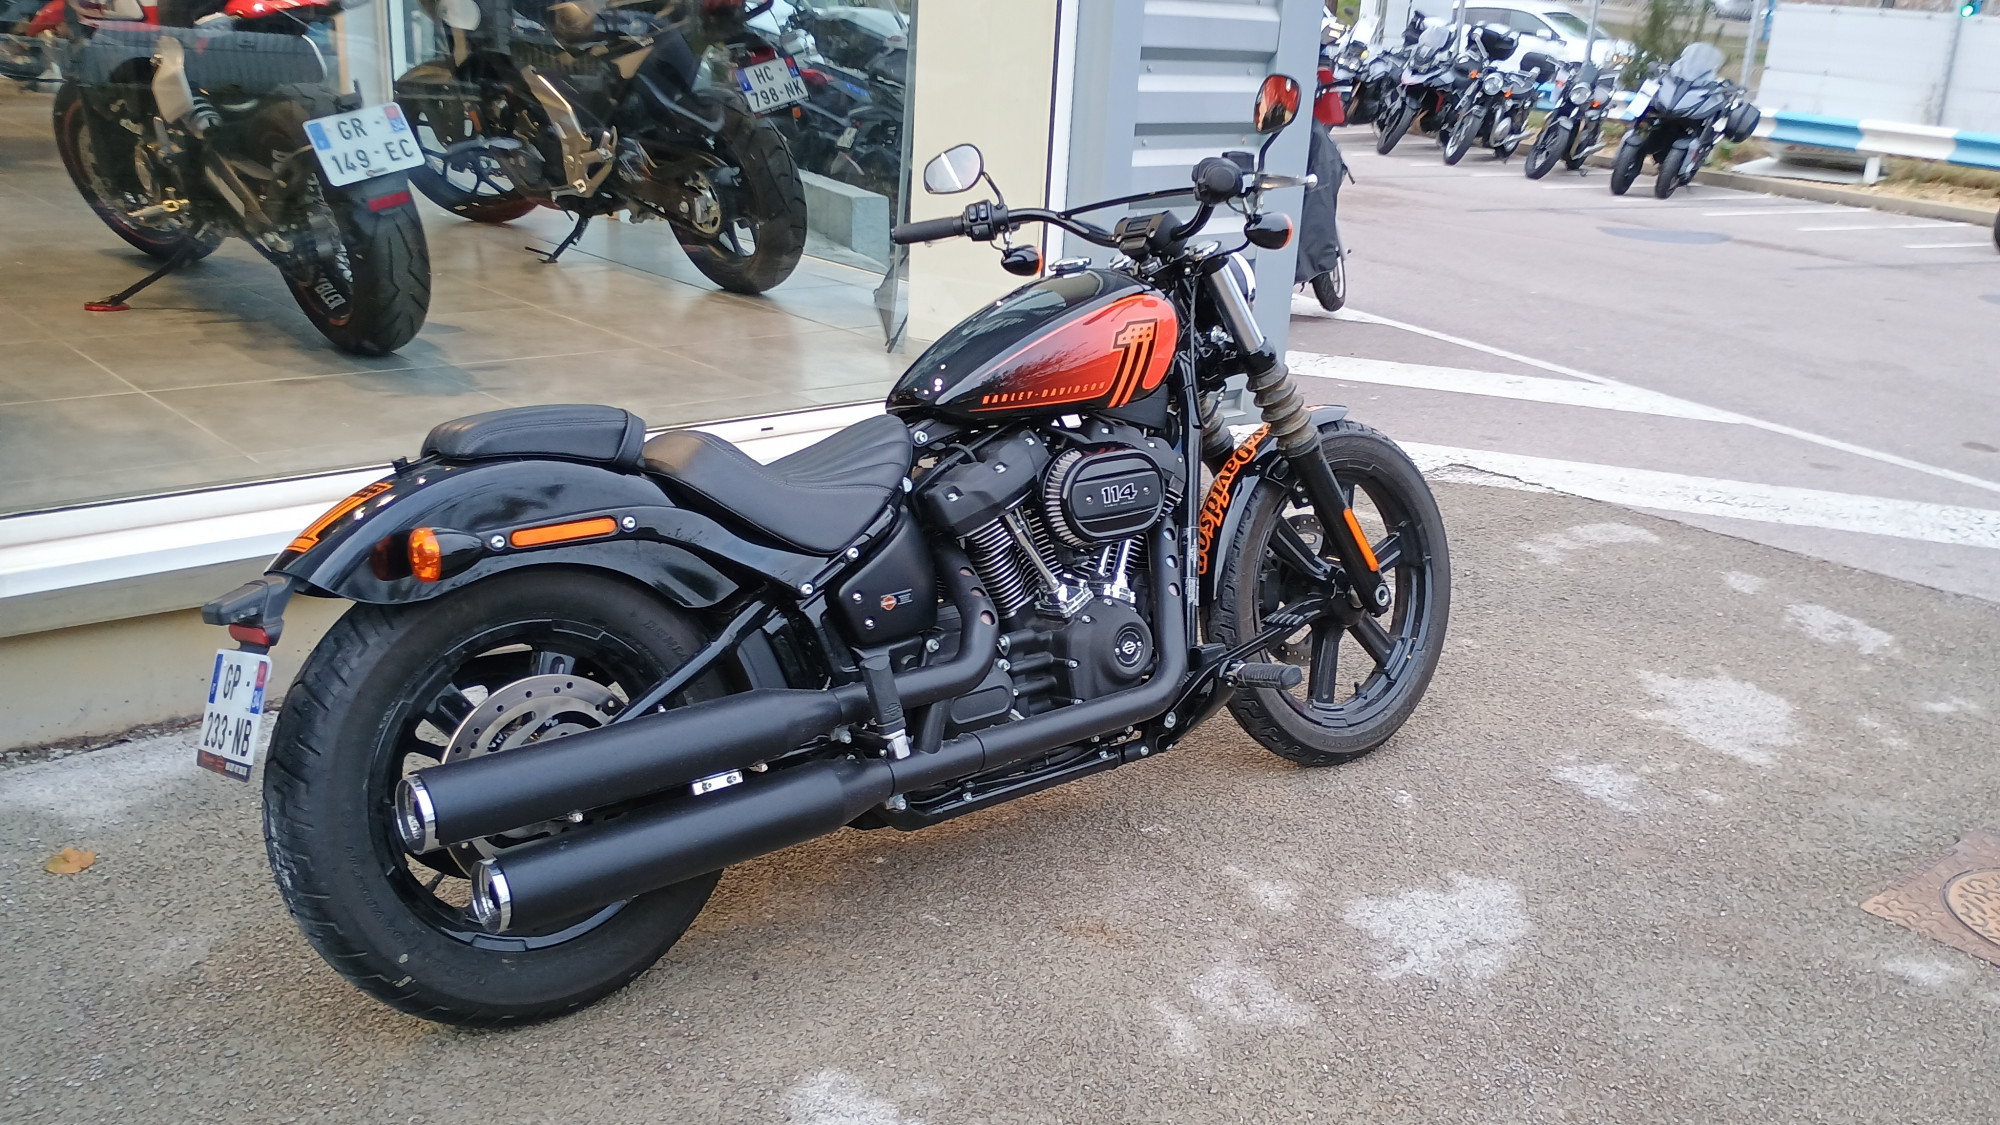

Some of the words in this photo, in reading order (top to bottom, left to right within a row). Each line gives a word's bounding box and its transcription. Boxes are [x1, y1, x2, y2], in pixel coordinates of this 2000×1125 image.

[750, 80, 804, 108] 798-NK
[331, 138, 414, 175] 149-EC
[981, 381, 1106, 405] HARLEY-DAVIDSON
[1101, 482, 1138, 505] 114
[203, 711, 253, 757] 233-NB
